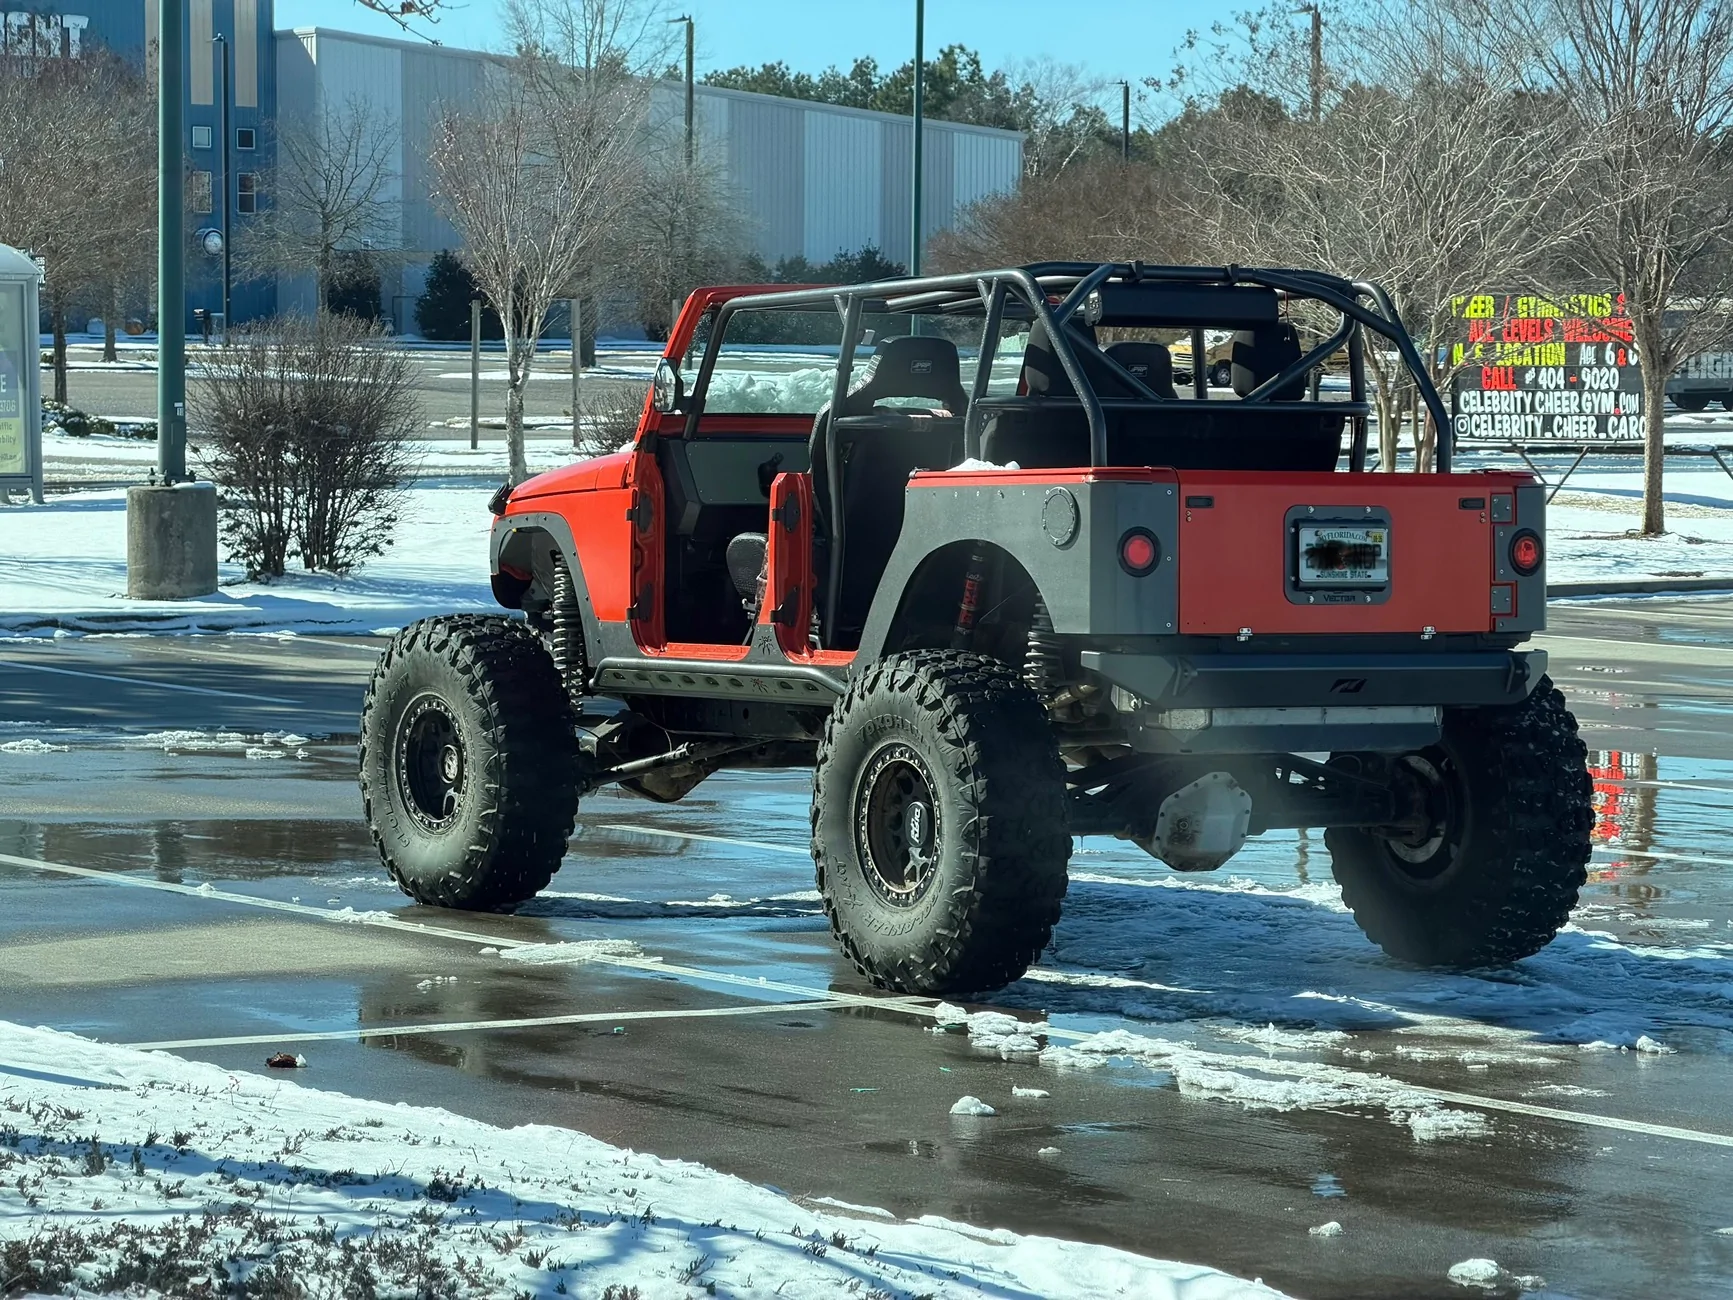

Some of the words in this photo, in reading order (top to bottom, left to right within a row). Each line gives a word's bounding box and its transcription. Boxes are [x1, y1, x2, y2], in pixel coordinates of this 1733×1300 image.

[1502, 319, 1553, 342] LEVELS
[1496, 343, 1566, 366] LOCATION
[1605, 343, 1615, 366] 6
[1482, 366, 1517, 390] CALL
[1538, 367, 1565, 390] 404
[1581, 367, 1619, 390] 9020
[1350, 570, 1368, 579] STATE
